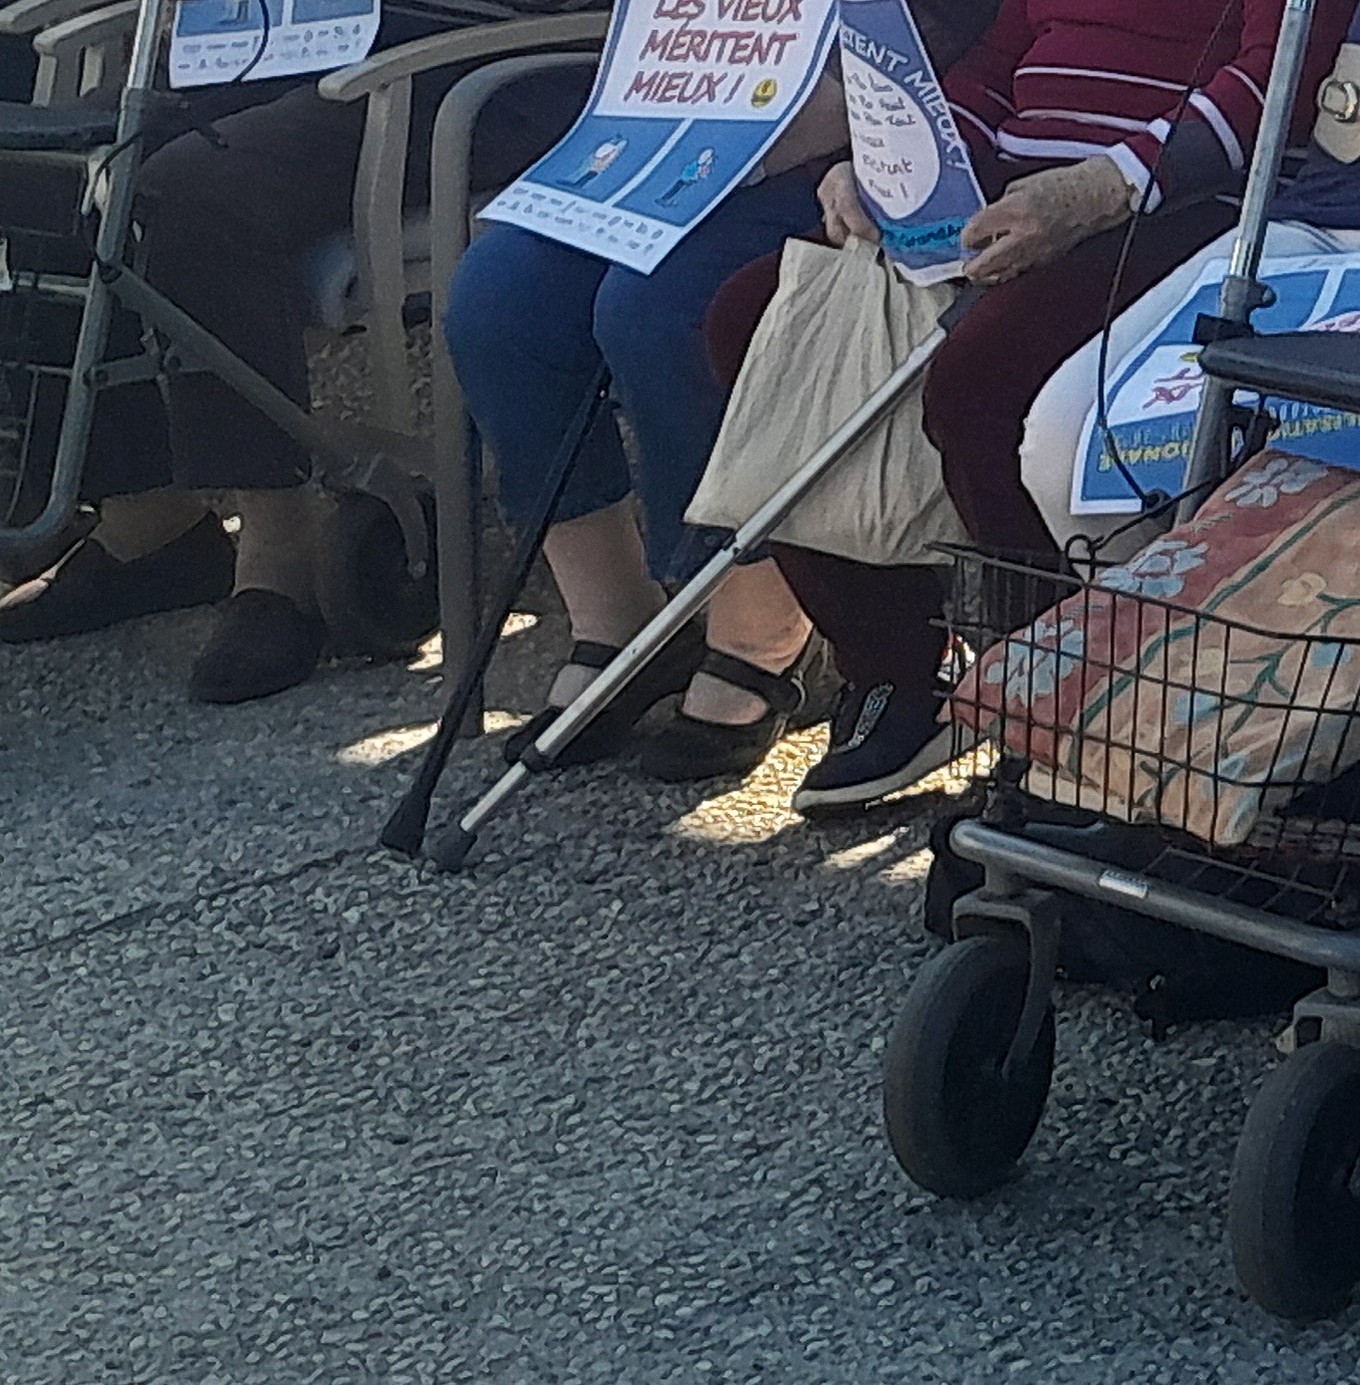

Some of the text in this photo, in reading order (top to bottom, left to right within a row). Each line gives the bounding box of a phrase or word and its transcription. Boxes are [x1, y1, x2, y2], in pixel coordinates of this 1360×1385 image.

[638, 18, 798, 66] MÉRITENT
[623, 70, 745, 105] MIEUX !
